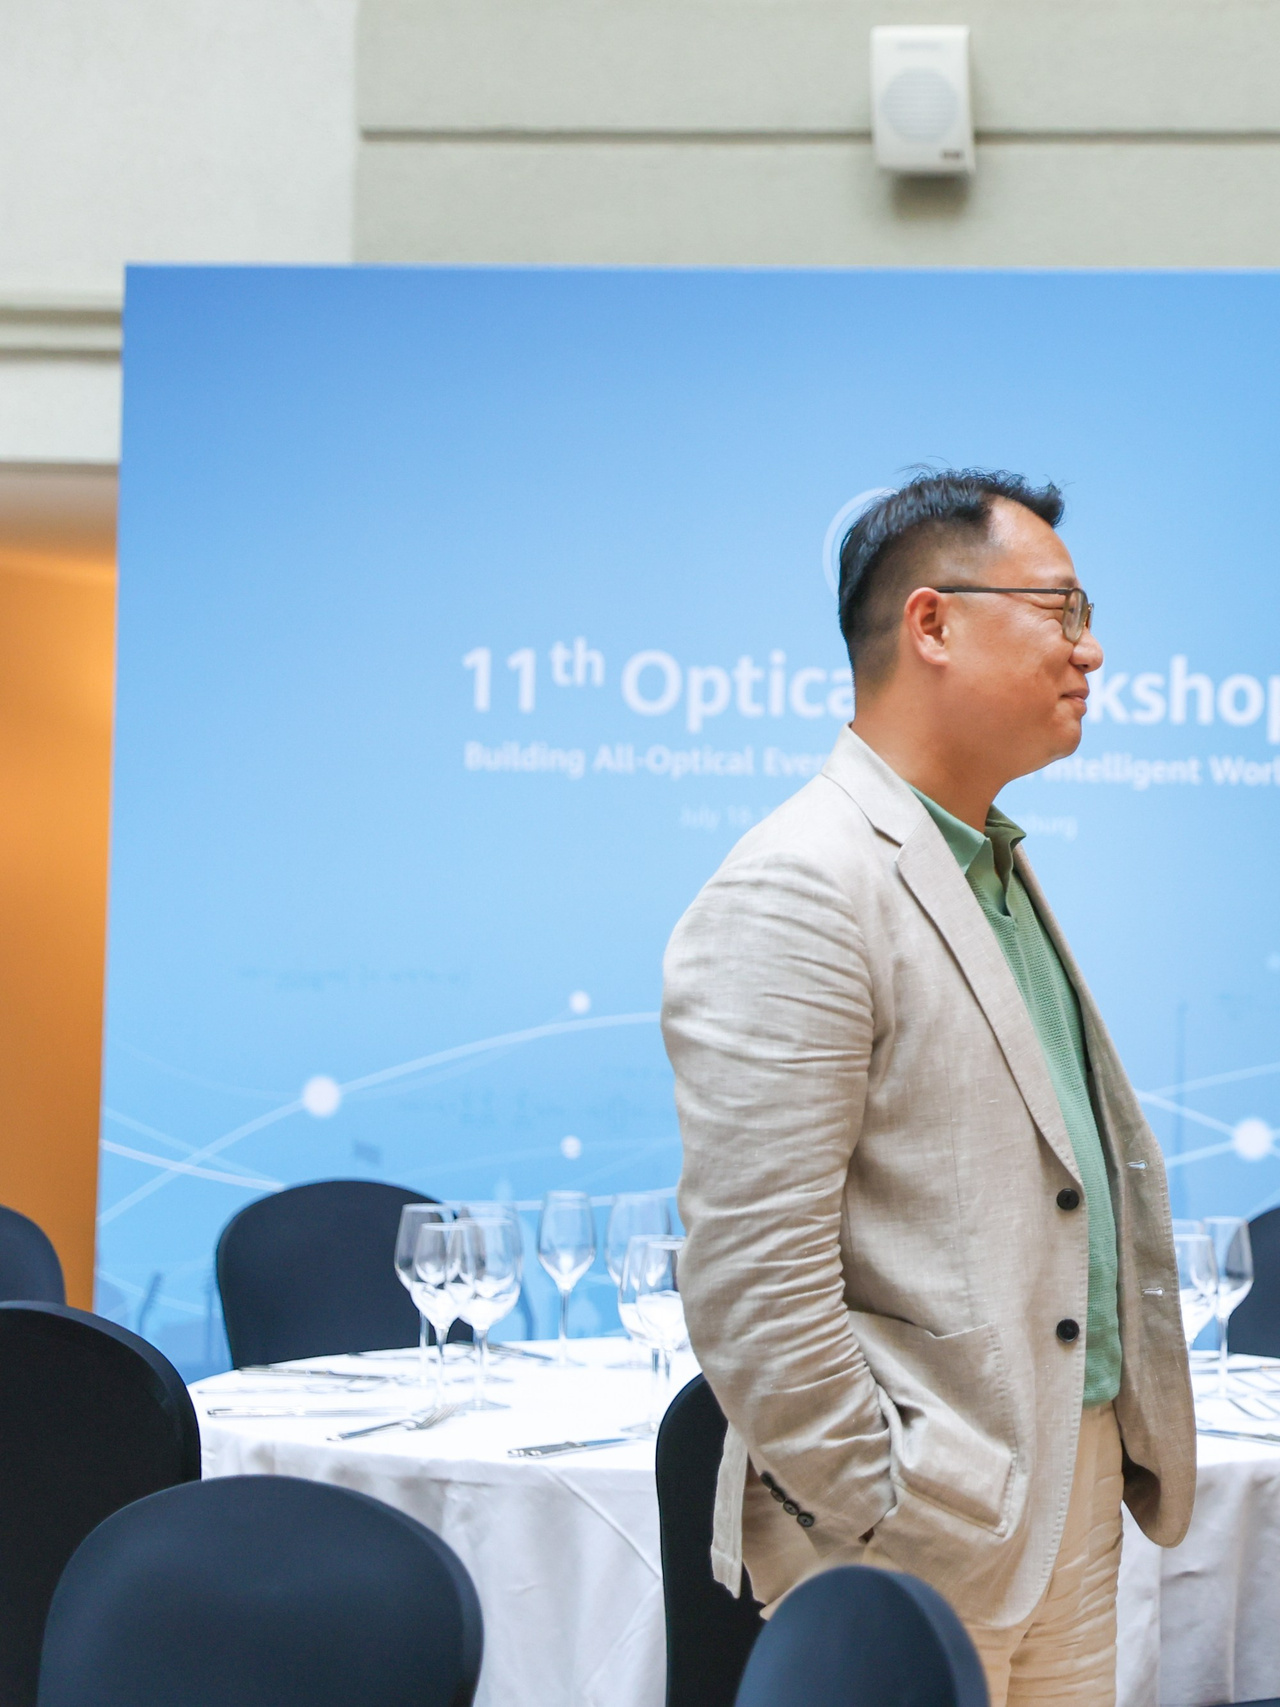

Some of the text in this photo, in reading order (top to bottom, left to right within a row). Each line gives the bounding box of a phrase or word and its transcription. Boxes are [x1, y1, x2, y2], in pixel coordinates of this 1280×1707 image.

[463, 636, 606, 713] 11th
[621, 649, 854, 732] Optica
[463, 741, 586, 780] Building
[592, 744, 754, 780] All-Optical
[763, 746, 827, 777] Ever
